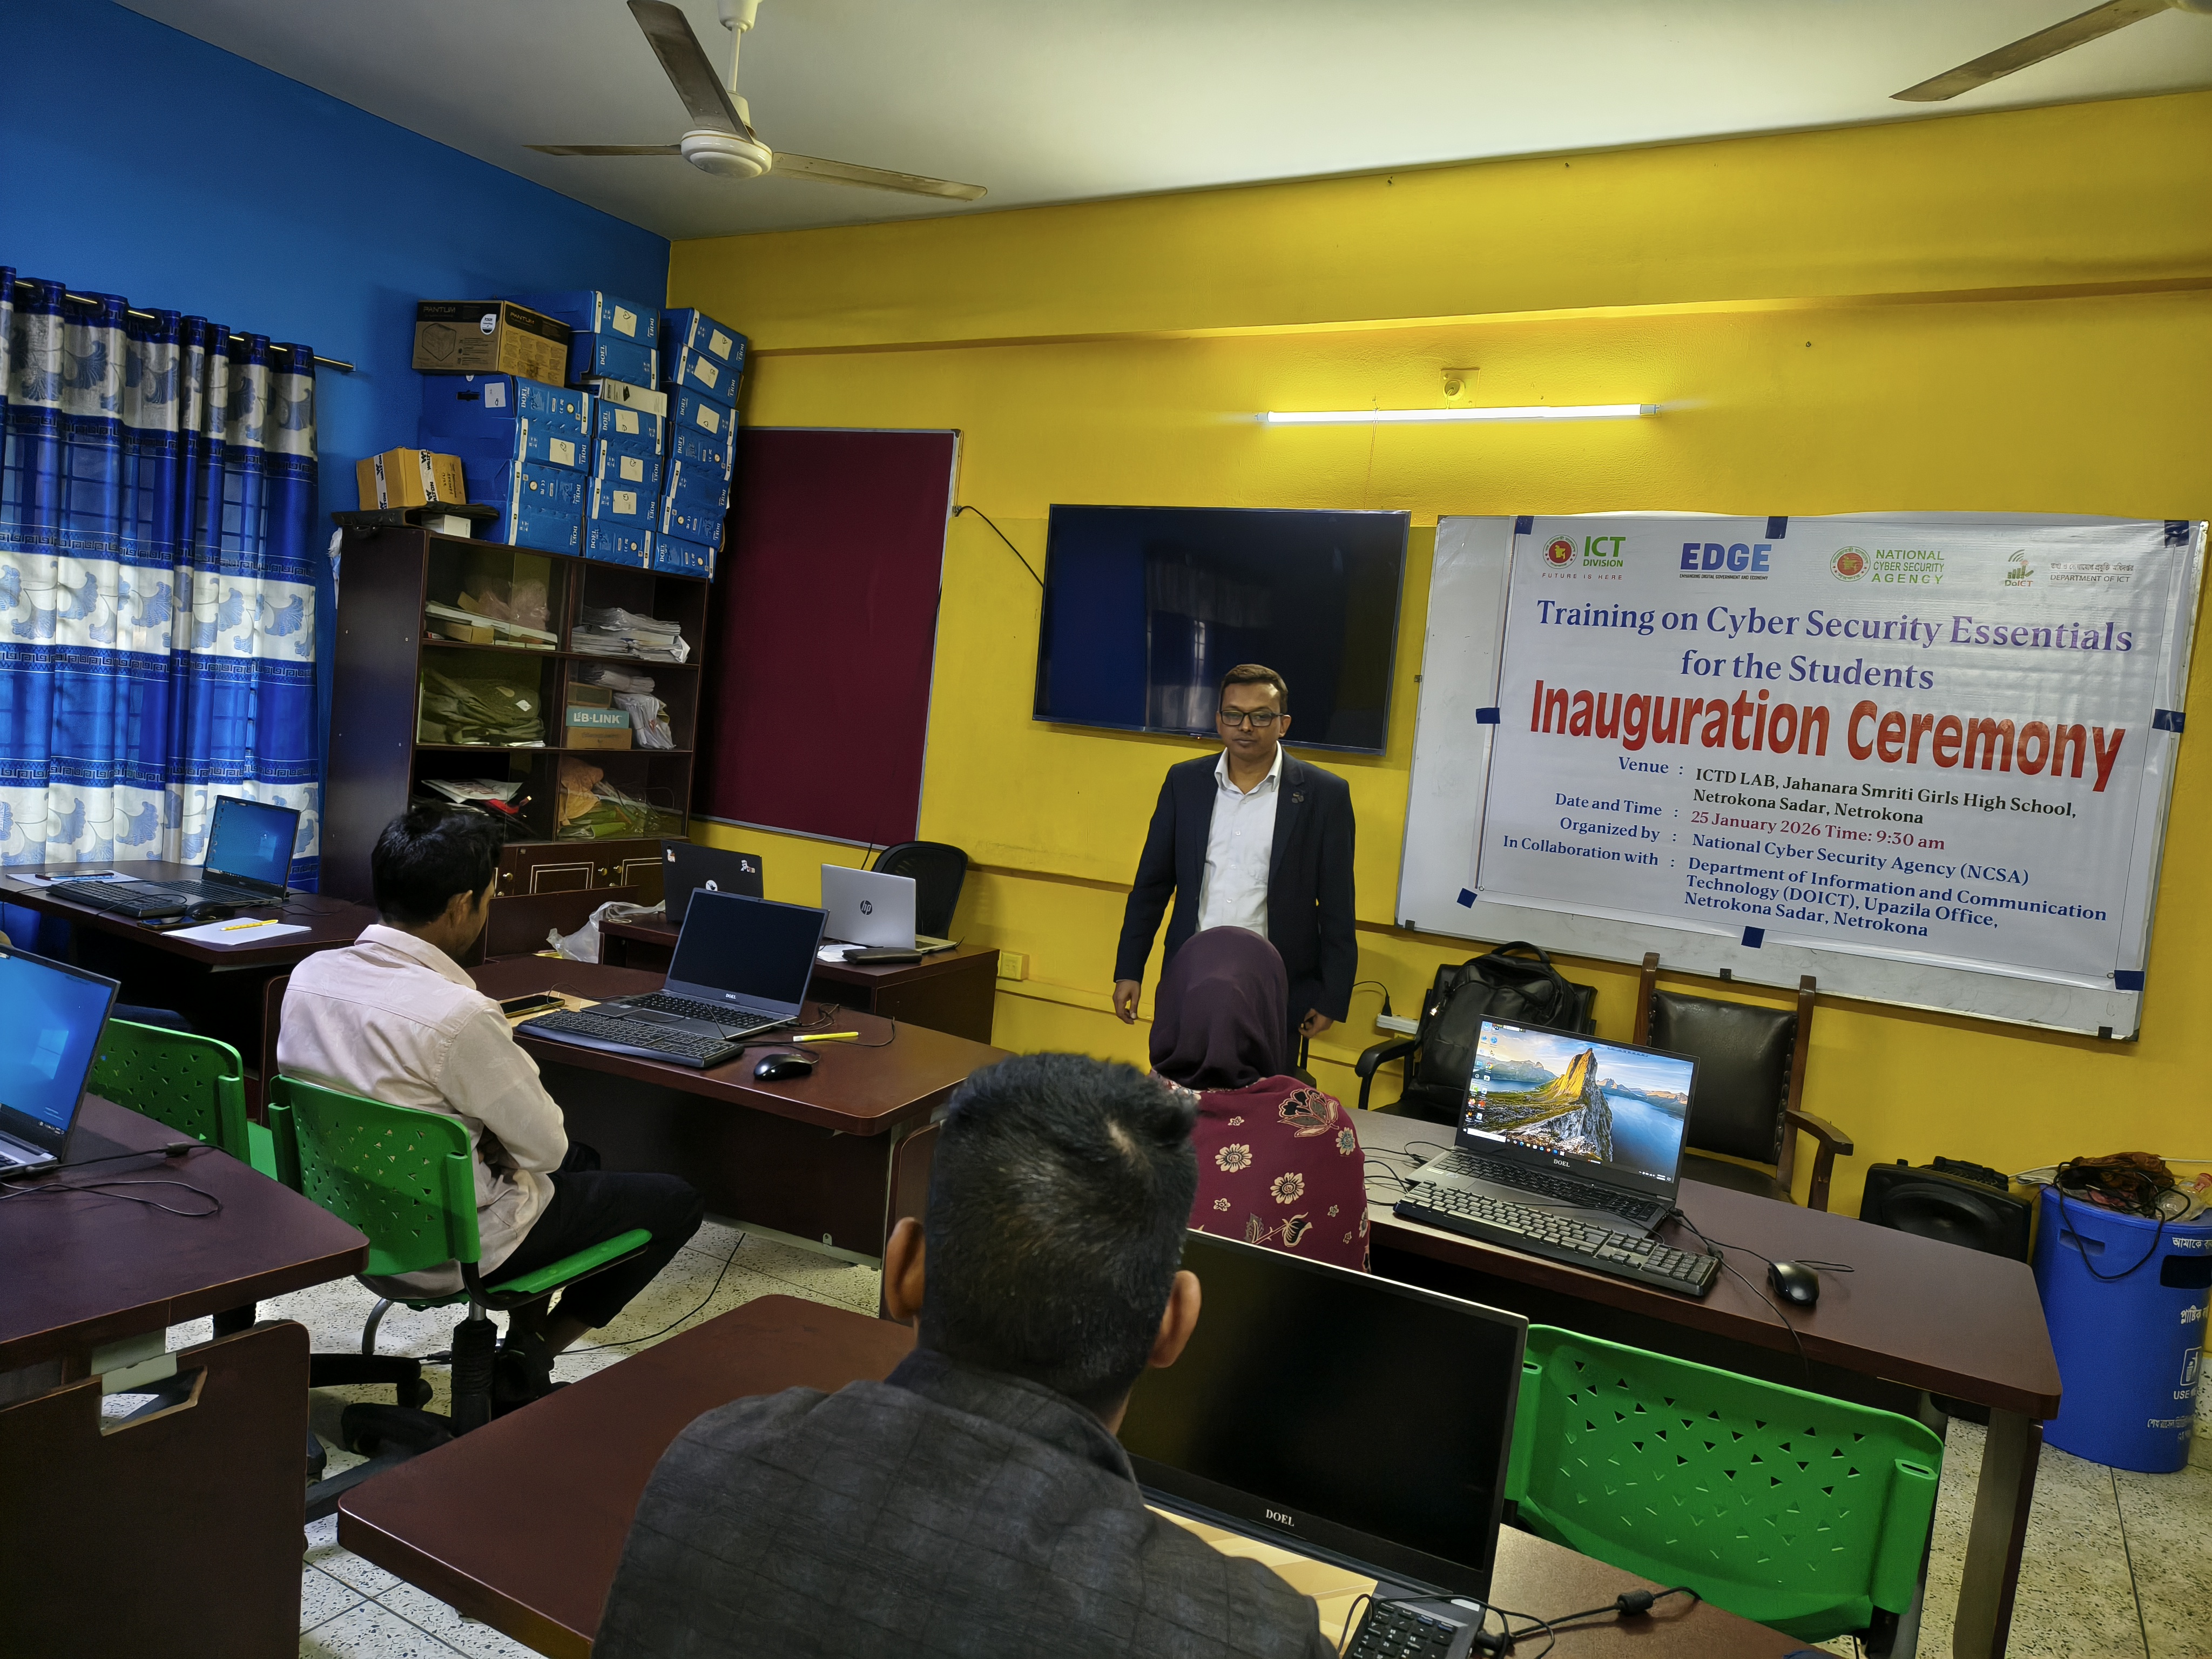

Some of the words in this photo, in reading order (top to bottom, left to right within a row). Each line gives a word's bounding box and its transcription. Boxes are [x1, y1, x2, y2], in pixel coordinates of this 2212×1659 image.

[1583, 536, 1626, 557] ICT
[1681, 543, 1772, 571] EDGE
[1876, 550, 1944, 561] NATIONAL
[1871, 574, 1943, 584] AGENCY
[1874, 561, 1901, 571] CYBER
[1903, 562, 1944, 572] SECURITY
[1537, 599, 1656, 635] Training
[1662, 611, 1698, 631] on
[1707, 606, 1800, 639] Cyber
[1806, 609, 1941, 648] Security
[1949, 615, 2133, 652] Essentials
[1680, 649, 1727, 677] for
[1734, 652, 1782, 680] the
[1788, 655, 1934, 690] Students
[1530, 679, 1830, 757] Inauguration
[1847, 700, 2126, 793] Ceremony
[1618, 757, 1669, 774] Venue
[1696, 768, 1737, 784] ICTD
[1741, 772, 1779, 790] LAB,
[1783, 777, 1858, 796] Jahanara
[1862, 784, 1913, 801] Smriti
[1918, 789, 1959, 806] Girls
[1964, 794, 2006, 814] High
[2011, 798, 2077, 819] School,
[1555, 793, 1589, 808] Date
[1591, 798, 1621, 812] and
[1624, 800, 1662, 817] Time
[1690, 811, 1709, 825] 25
[1712, 812, 1777, 834] January
[1780, 820, 1821, 837] 2026
[1825, 825, 1873, 842] Time:
[1877, 830, 1914, 847] 9:30
[1918, 837, 1945, 851] am
[1694, 789, 1776, 809] Netrokona
[1779, 797, 1830, 815] Sadar,
[1834, 802, 1924, 824] Netrokona
[1560, 817, 1637, 838] Organized
[1641, 826, 1661, 843] by
[1692, 834, 1761, 854] National
[1764, 842, 1814, 860] Cyber
[1817, 848, 1887, 871] Security
[1891, 857, 1957, 879] Agency
[1960, 862, 2029, 886] (NCSA)
[1503, 836, 1518, 849] In
[1521, 837, 1621, 861] Collaboration
[1625, 851, 1659, 866] with
[1688, 857, 1785, 881] Department
[1789, 868, 1808, 884] of
[1811, 872, 1916, 898] Information
[1919, 885, 1952, 902] and
[1957, 890, 2107, 921] Communication
[861, 900, 872, 915] hp
[1684, 891, 1772, 916] Netrokona
[1776, 904, 1829, 926] Sadar,
[1834, 912, 1928, 938] Netrokona
[1687, 875, 1779, 901] Technology
[1783, 886, 1860, 911] (DOICT),
[1864, 898, 1931, 919] Upazila
[1935, 906, 1998, 929] Office,
[1553, 1158, 1570, 1168] DOEL
[2172, 1237, 2204, 1249] আমাকে
[2174, 1390, 2190, 1400] USE
[1266, 1509, 1295, 1527] DOEL
